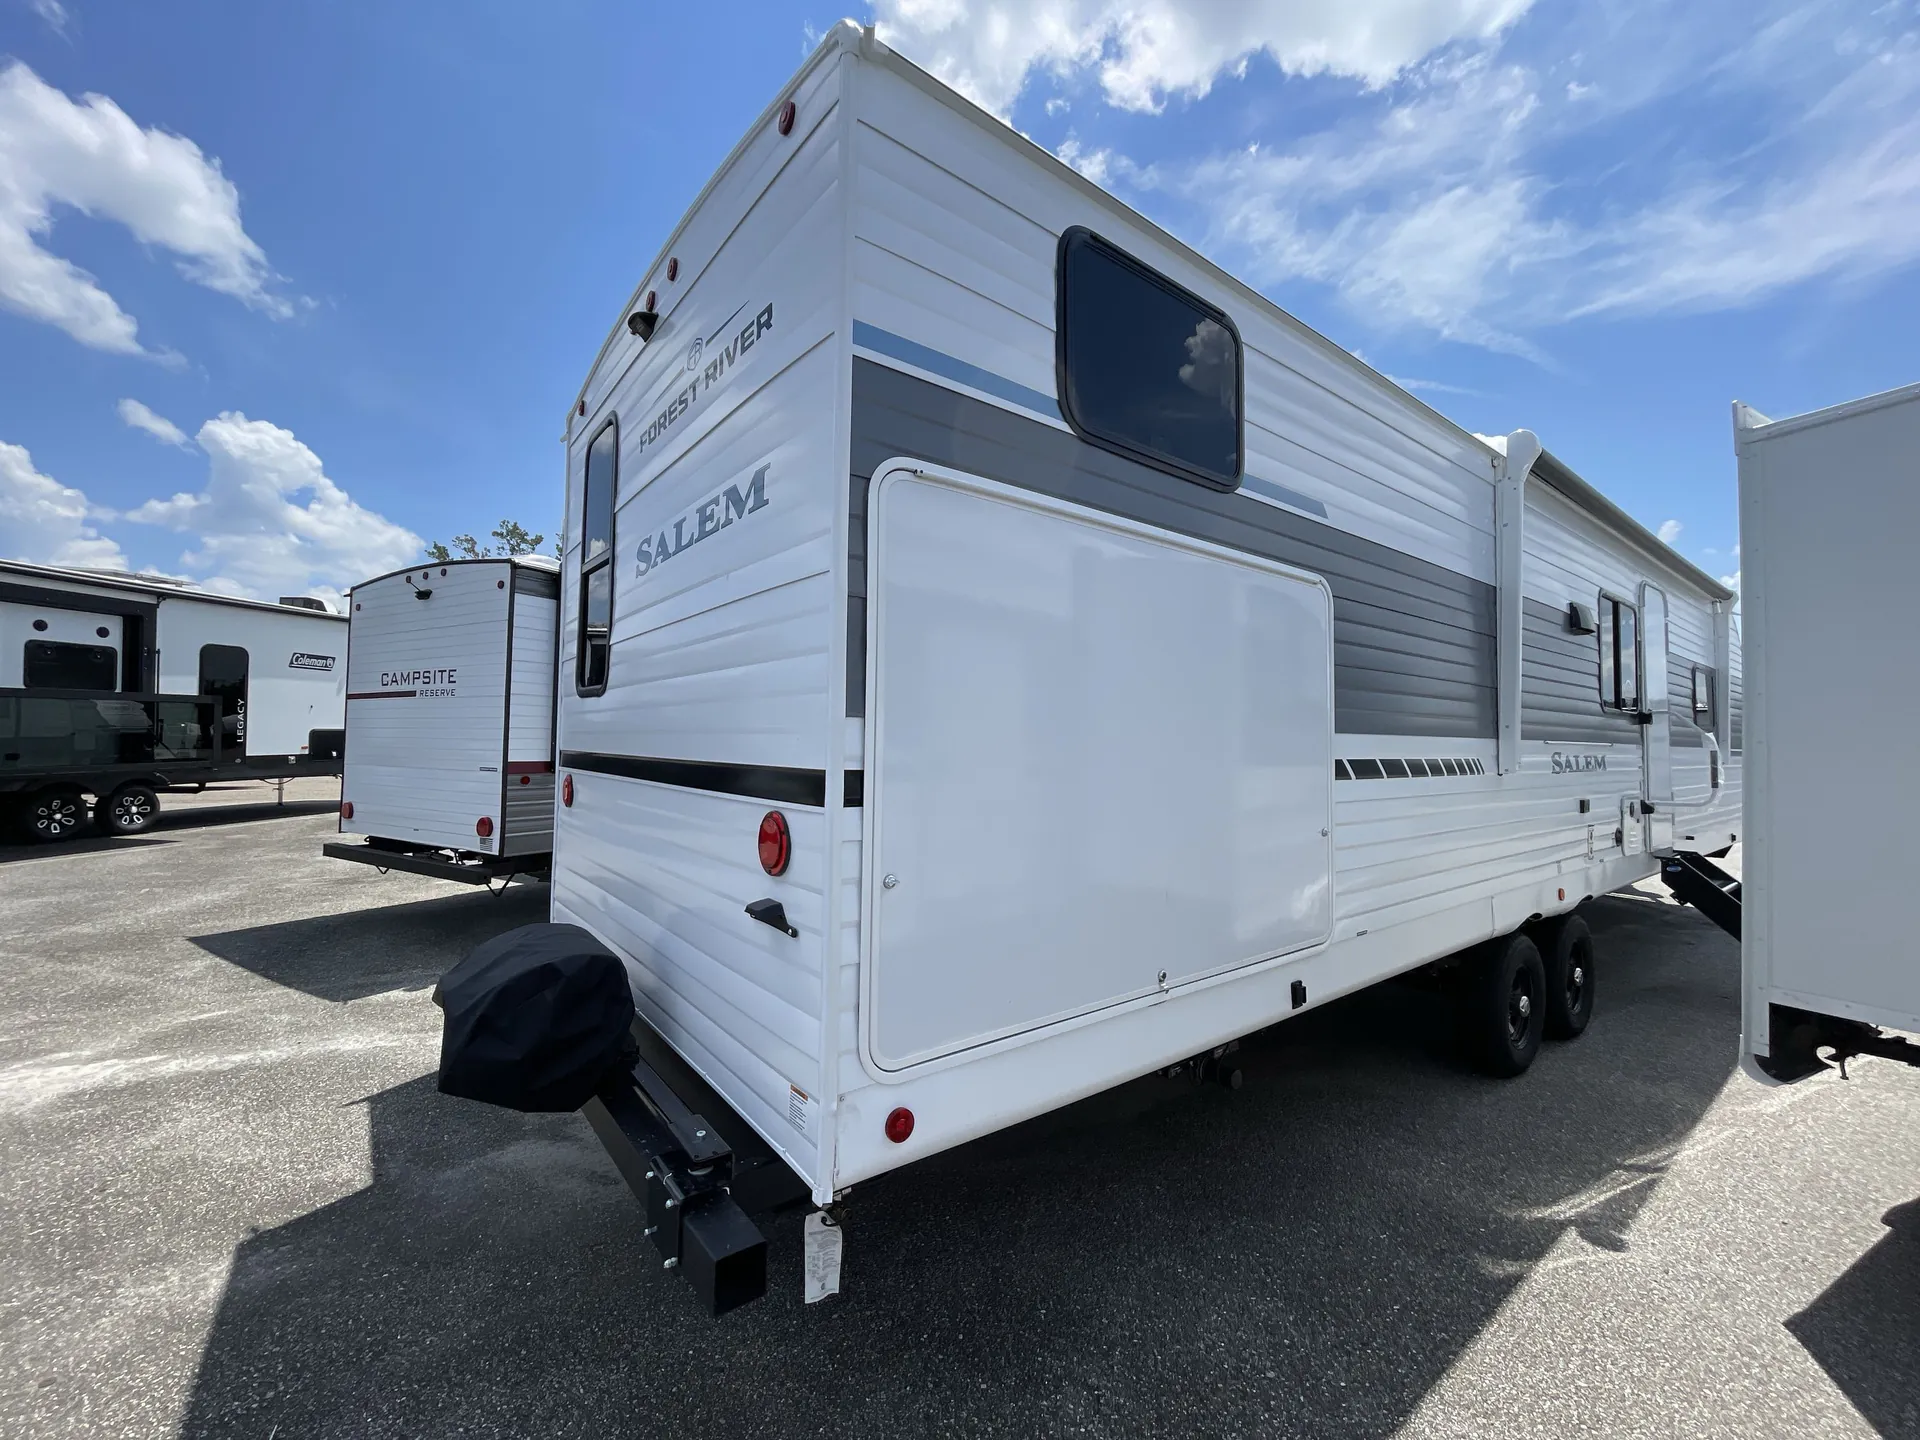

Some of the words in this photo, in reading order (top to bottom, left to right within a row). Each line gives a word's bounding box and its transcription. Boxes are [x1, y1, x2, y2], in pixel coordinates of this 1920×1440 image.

[640, 374, 701, 454] FOREST
[703, 302, 773, 391] RIVER
[635, 462, 771, 579] SALEM
[292, 653, 327, 667] Coleman
[380, 669, 457, 687] CAMPSITE
[419, 688, 456, 698] RESERVE
[236, 698, 245, 743] LEGACY
[1551, 752, 1608, 774] SALEM
